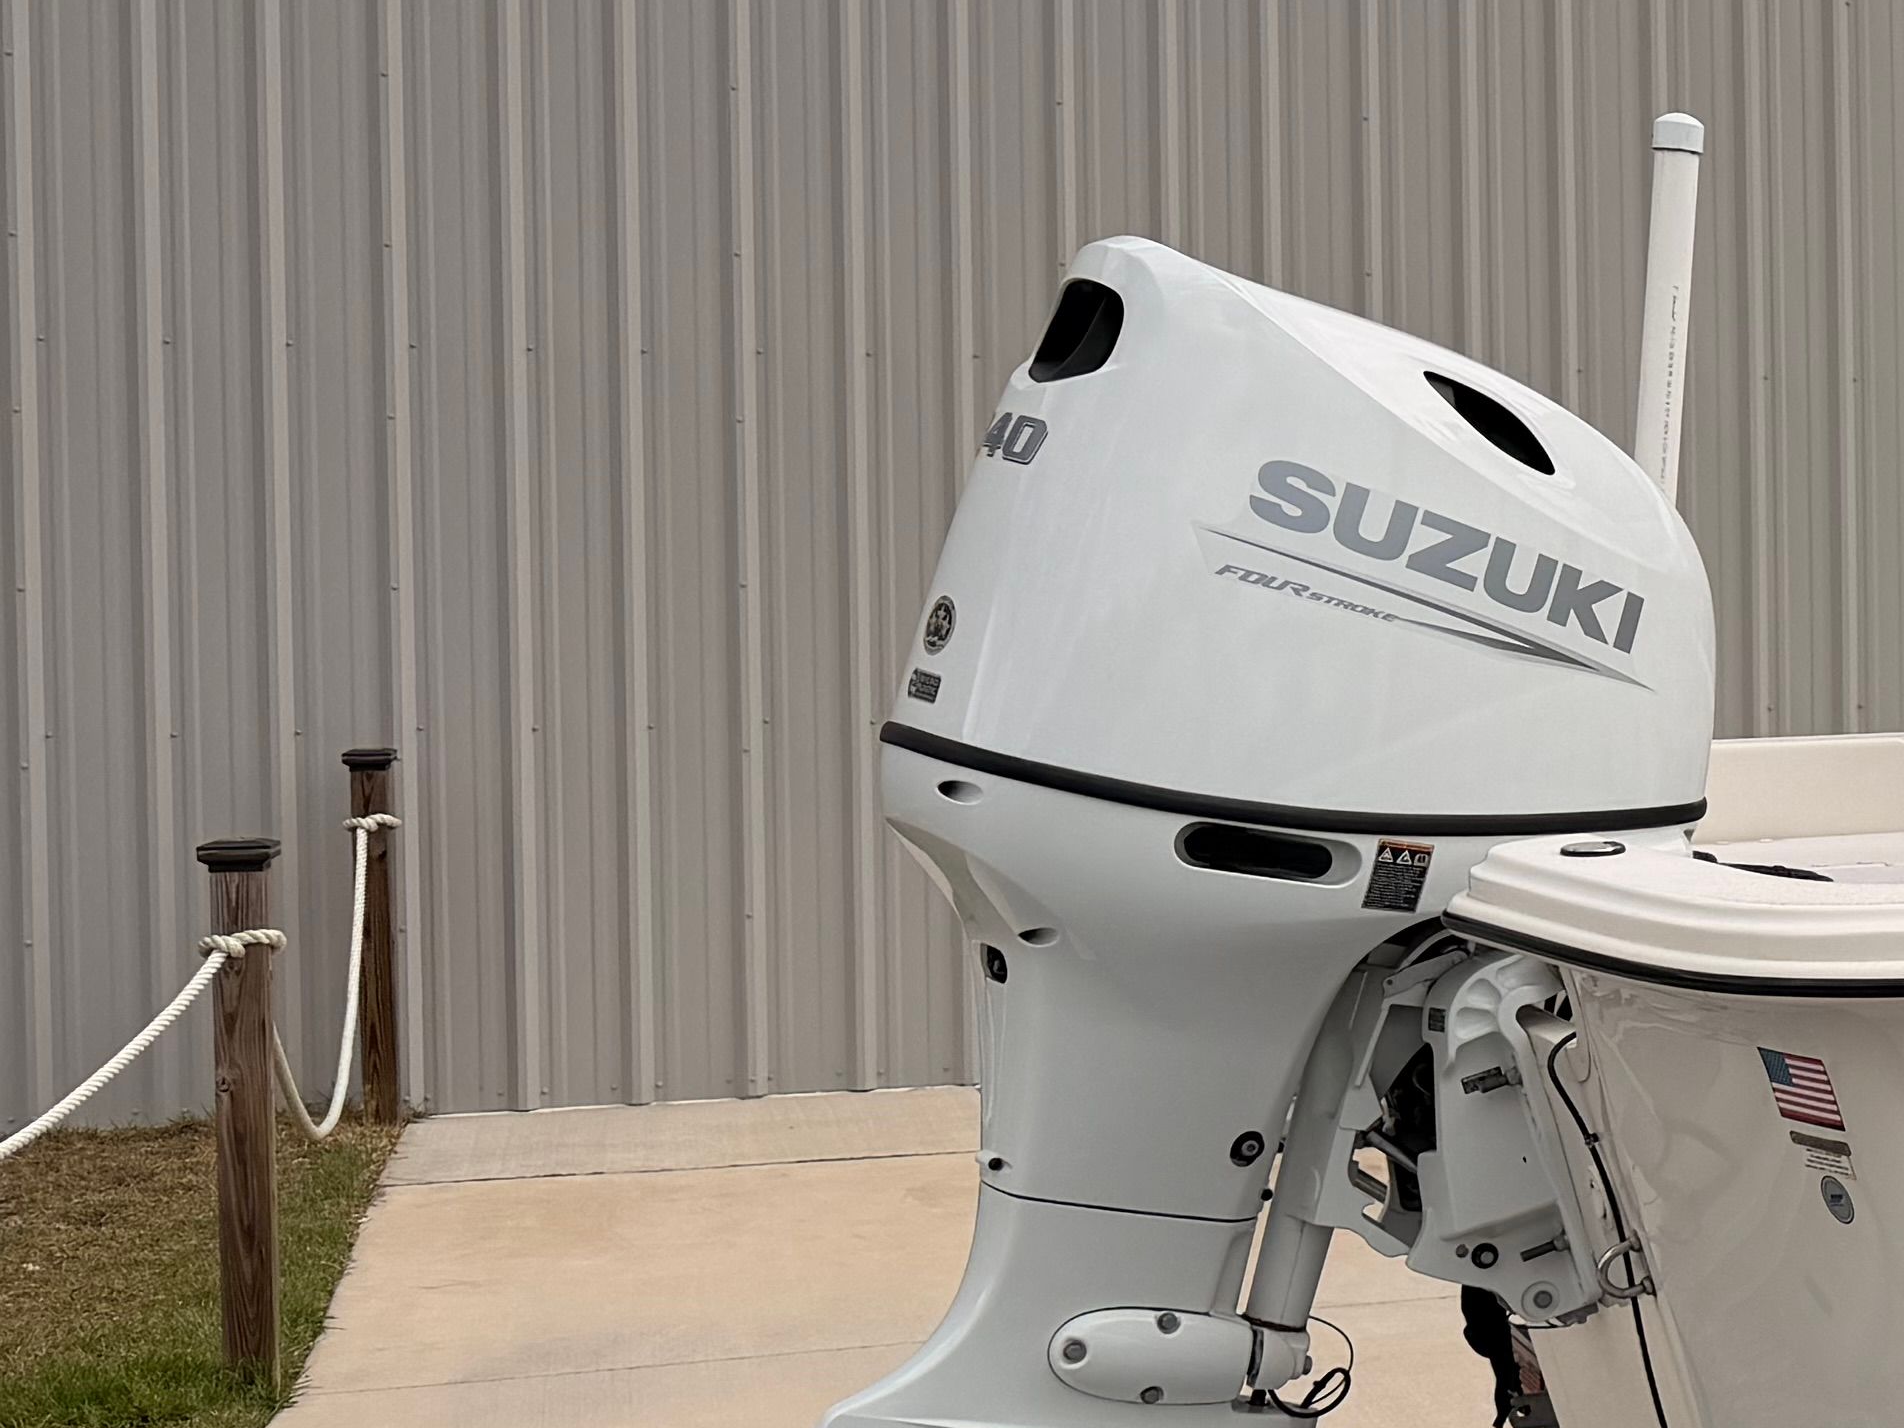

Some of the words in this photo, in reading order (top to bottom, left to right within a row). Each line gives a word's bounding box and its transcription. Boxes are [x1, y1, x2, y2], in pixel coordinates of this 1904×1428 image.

[1215, 564, 1311, 596] FOUR
[1309, 590, 1399, 623] STROKE
[1249, 460, 1645, 654] SUZUKI
